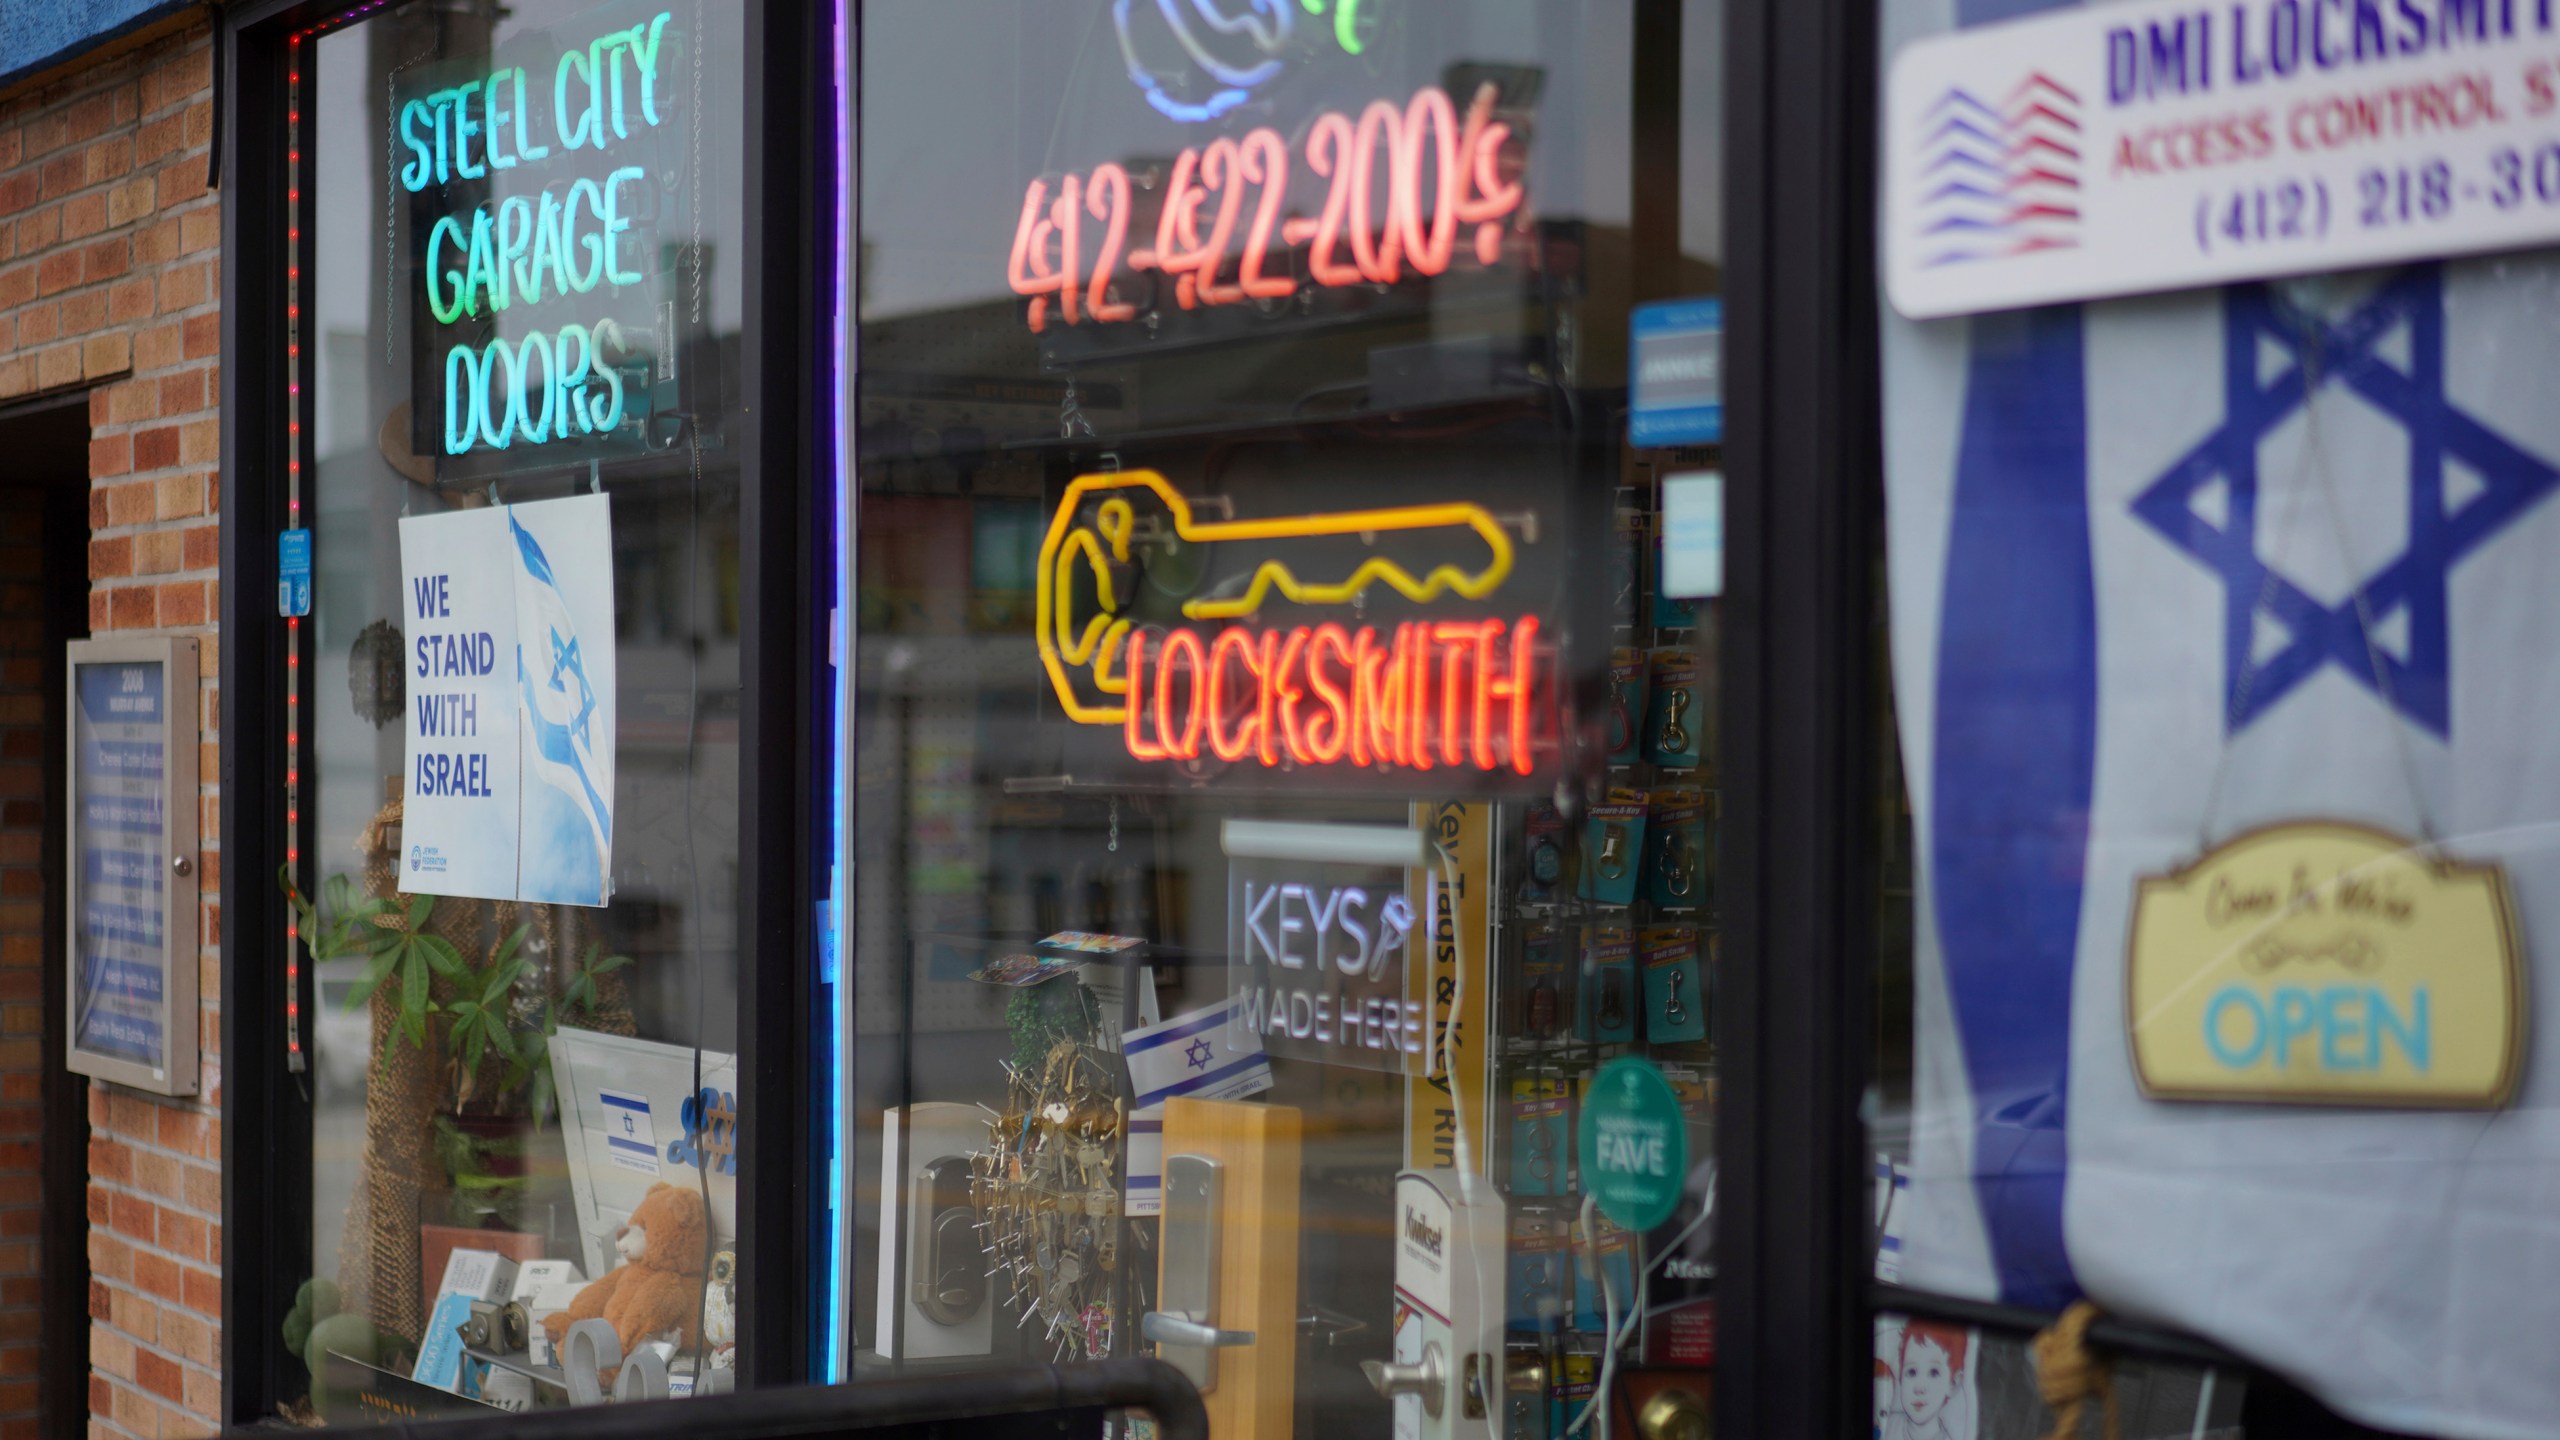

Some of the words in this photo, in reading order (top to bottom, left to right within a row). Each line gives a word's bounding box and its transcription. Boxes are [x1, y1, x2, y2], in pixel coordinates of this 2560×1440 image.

[2107, 13, 2211, 105] DMI
[401, 66, 548, 192] STEEL
[554, 12, 671, 149] CITY
[2113, 108, 2275, 180] ACCESS
[2288, 72, 2507, 155] CONTROL
[2523, 58, 2560, 116] S
[426, 166, 644, 324] GARAGE
[2194, 178, 2332, 255] (412)
[446, 317, 624, 456] DOORS
[414, 574, 451, 620] WE
[416, 631, 495, 679] STAND
[1124, 614, 1540, 776] LOCKSMITH
[417, 693, 478, 738] WITH
[416, 753, 492, 798] ISRAEL
[1244, 880, 1369, 976] KEYS
[1238, 984, 1332, 1041] MADE
[1340, 996, 1423, 1053] HERE
[2203, 984, 2432, 1072] OPEN
[1596, 1134, 1669, 1177] FAVE
[1405, 1204, 1442, 1260] Kwikset
